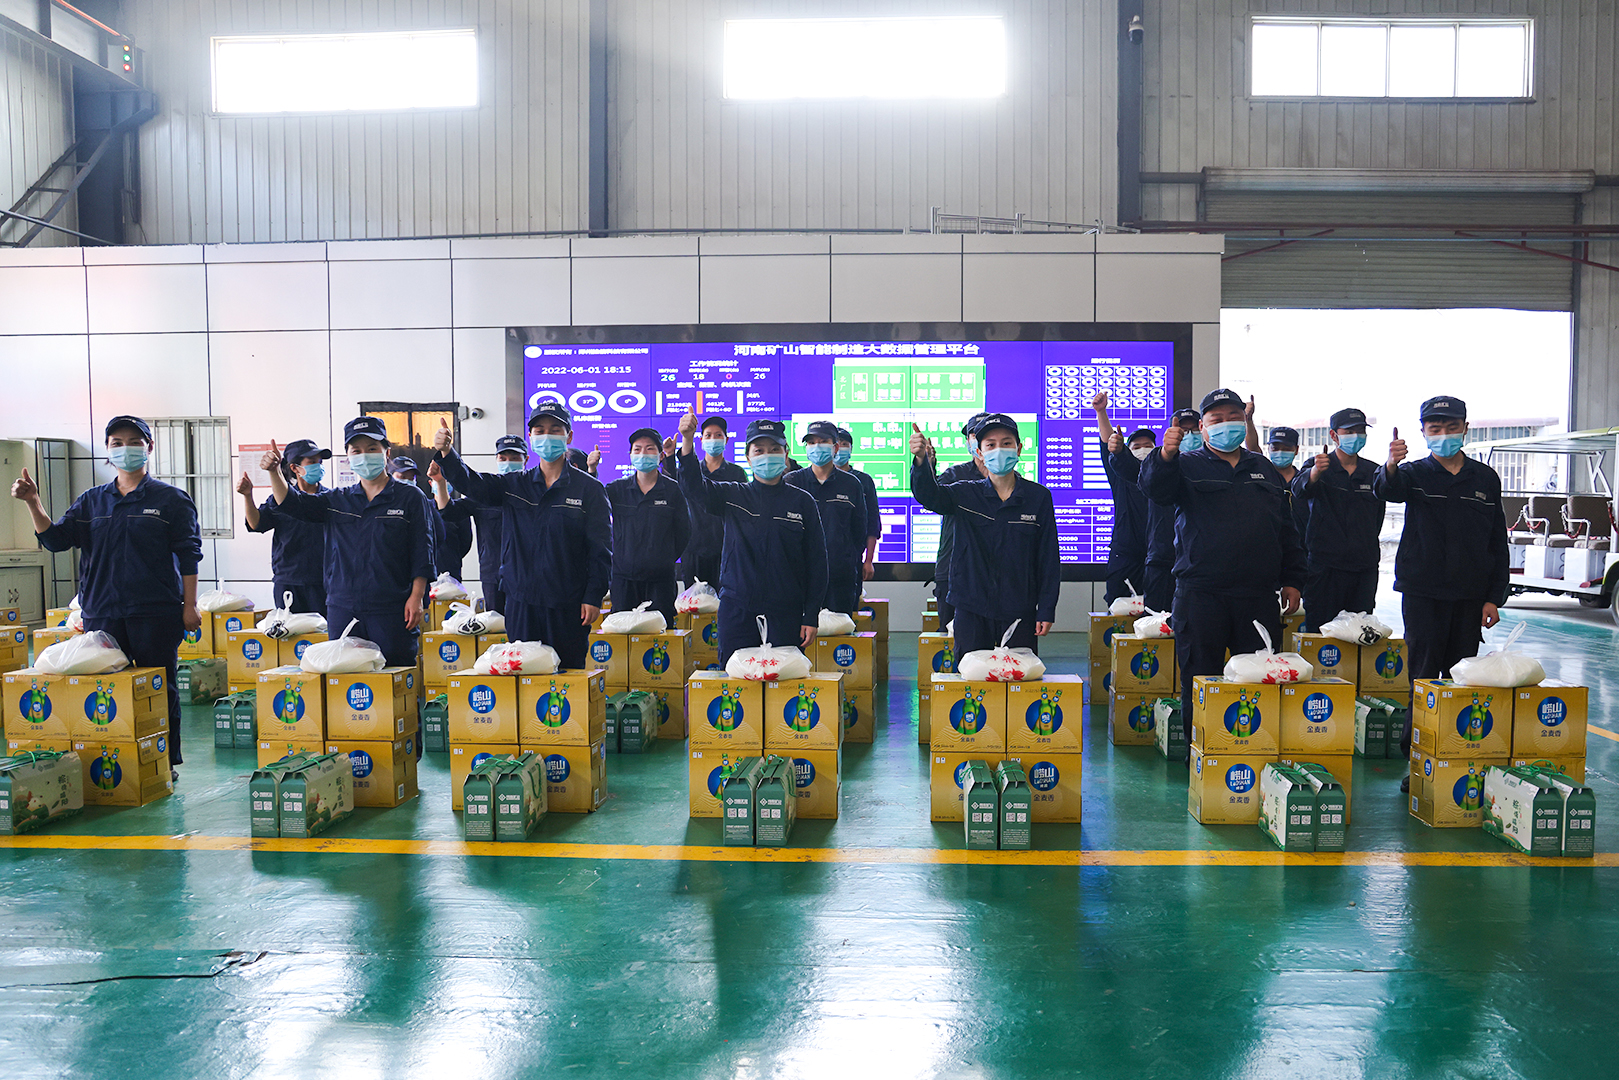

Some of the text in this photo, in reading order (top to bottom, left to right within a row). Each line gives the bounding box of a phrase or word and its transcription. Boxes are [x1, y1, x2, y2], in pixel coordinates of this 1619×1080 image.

[734, 344, 980, 356] 河南矿山智能制造大数据管理平台
[351, 688, 369, 699] 崂山
[473, 690, 491, 701] 崂山
[1308, 699, 1328, 709] 崂山
[1542, 702, 1562, 714] 崂山
[1034, 768, 1054, 778] 崂山
[1230, 769, 1250, 780] 崂山
